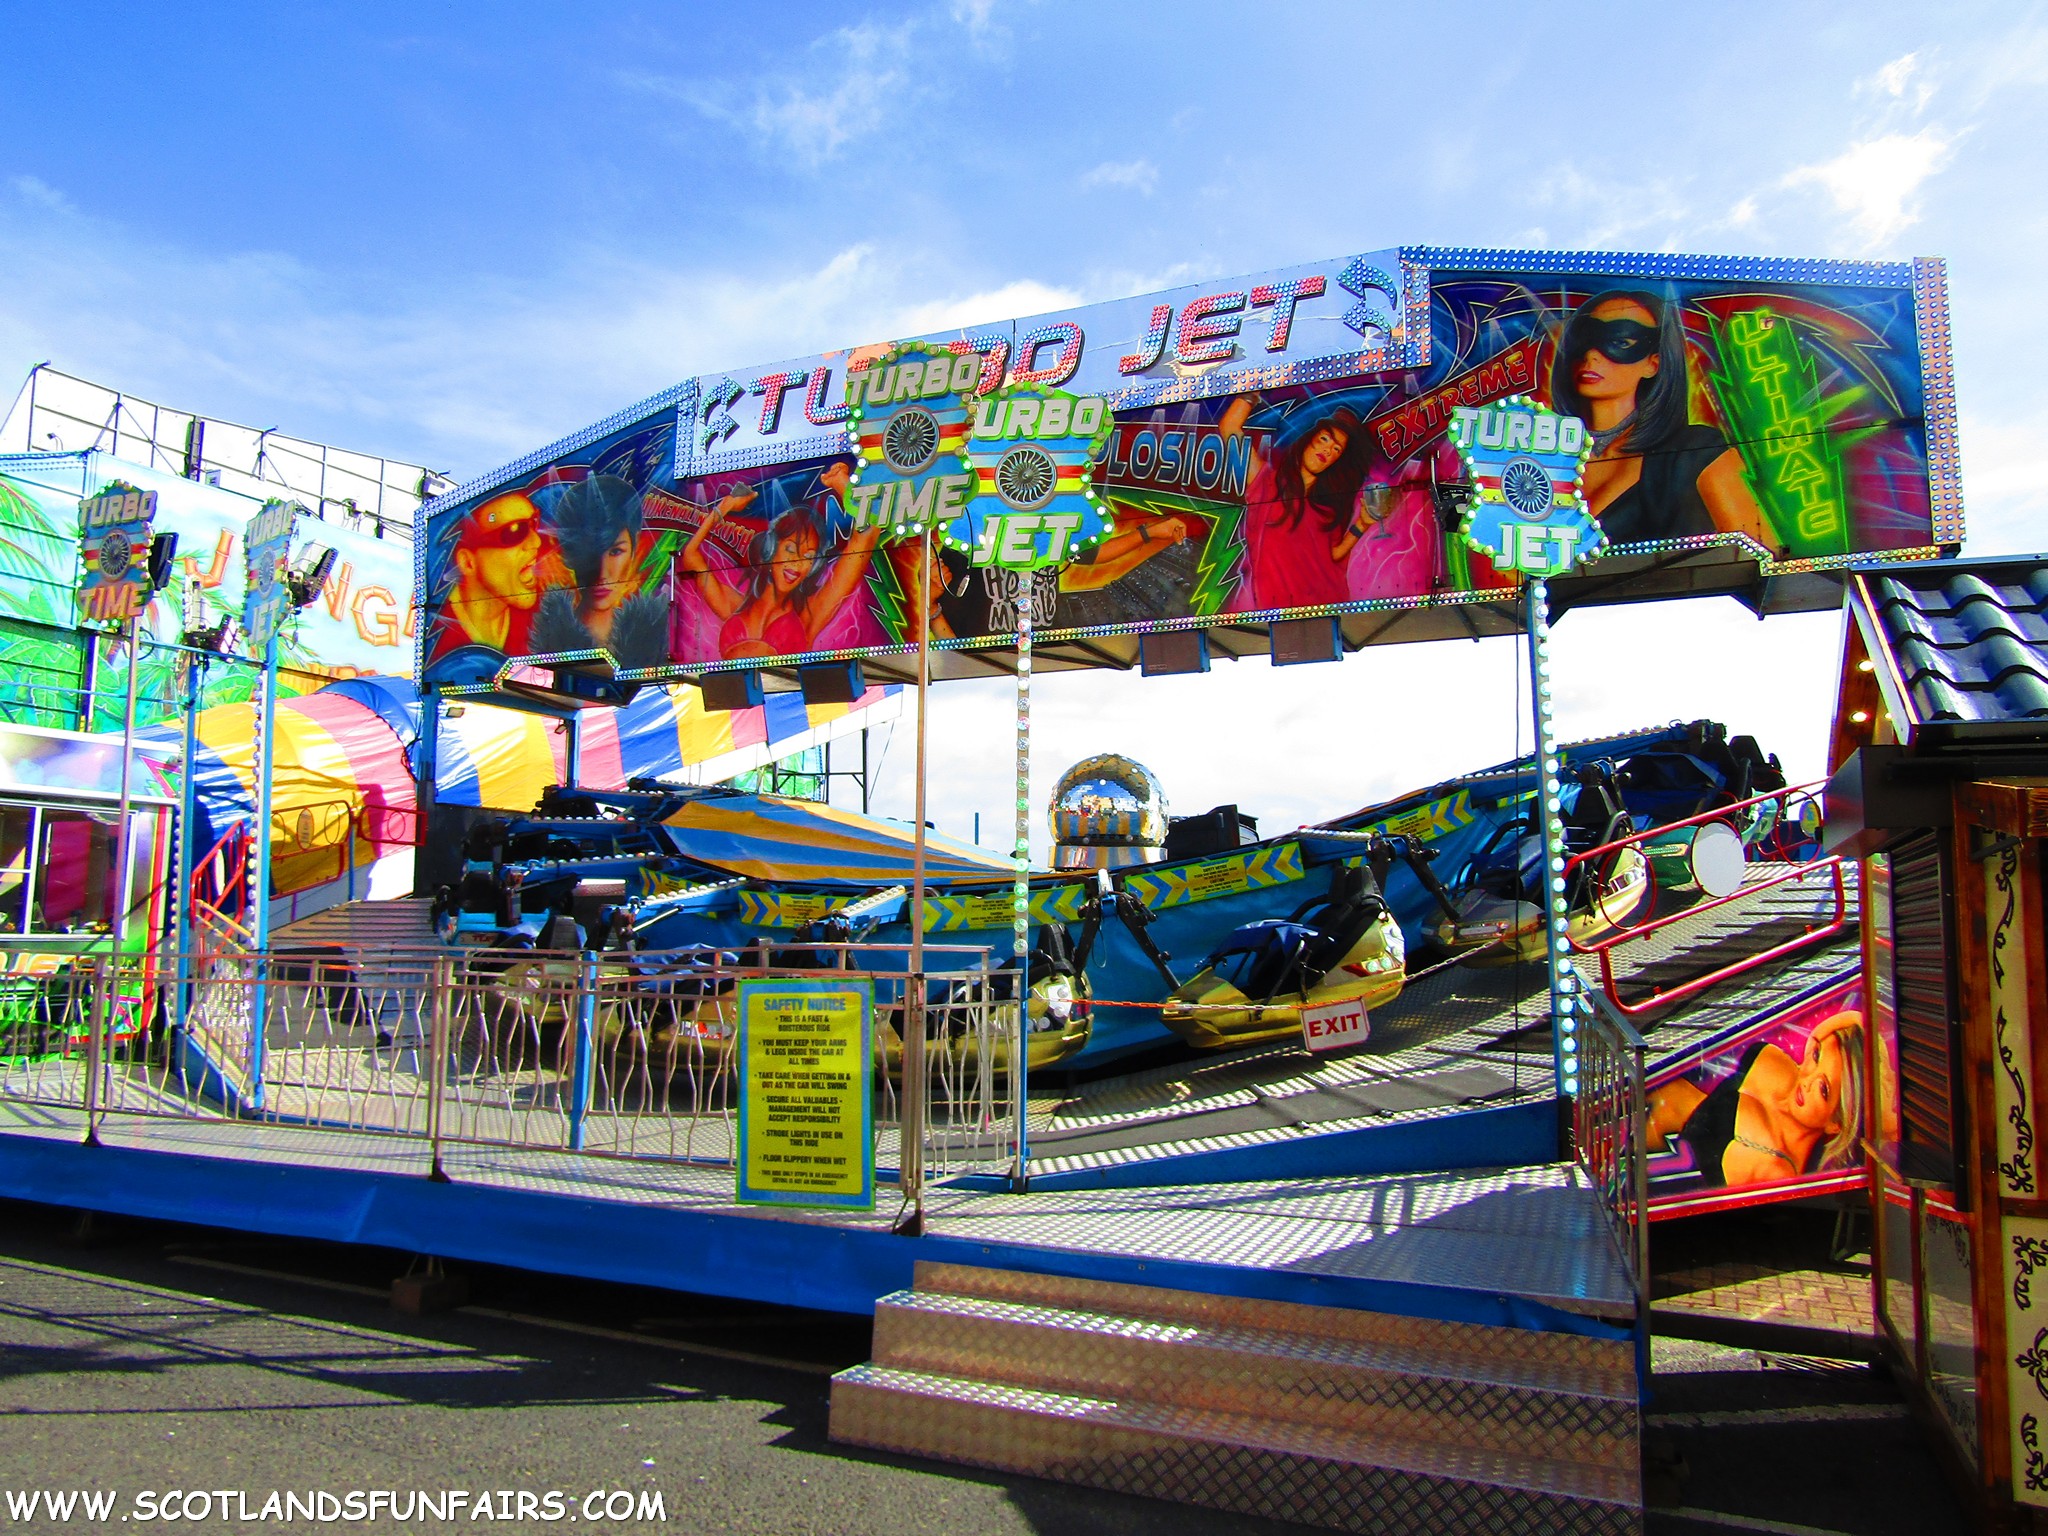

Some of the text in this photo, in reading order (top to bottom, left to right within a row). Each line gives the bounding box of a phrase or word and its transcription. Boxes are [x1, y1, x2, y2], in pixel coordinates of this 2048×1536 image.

[748, 274, 1327, 434] TUBO JET
[847, 354, 981, 406] TURBO
[974, 398, 1106, 438] URBO
[1378, 351, 1529, 460] EXTREME
[1731, 309, 1837, 537] ULTIMATE
[1457, 408, 1584, 453] TURBO
[1094, 429, 1252, 496] LOSION
[79, 490, 157, 527] TURBO
[851, 474, 972, 528] TIME
[246, 499, 295, 548] TURBO
[710, 520, 756, 558] RUSH
[973, 515, 1080, 564] JET
[1494, 524, 1580, 570] JET
[78, 582, 149, 623] TIME
[249, 597, 282, 646] JET
[764, 997, 847, 1011] SAFETY NOTICE
[778, 1024, 830, 1032] BOISTEROUS RIDE
[1308, 1013, 1361, 1037] EXIT
[768, 1105, 810, 1113] MANAGEMENT
[768, 1114, 840, 1123] ACCEPT RESPONSIBILITY
[803, 1096, 838, 1104] VALUABLES
[790, 1130, 811, 1138] LIGHTS
[821, 1131, 833, 1139] USE
[805, 1139, 818, 1147] RIDE
[763, 1154, 782, 1162] FLOOR
[784, 1155, 812, 1163] SLIPPERY
[814, 1156, 832, 1164] WHEN
